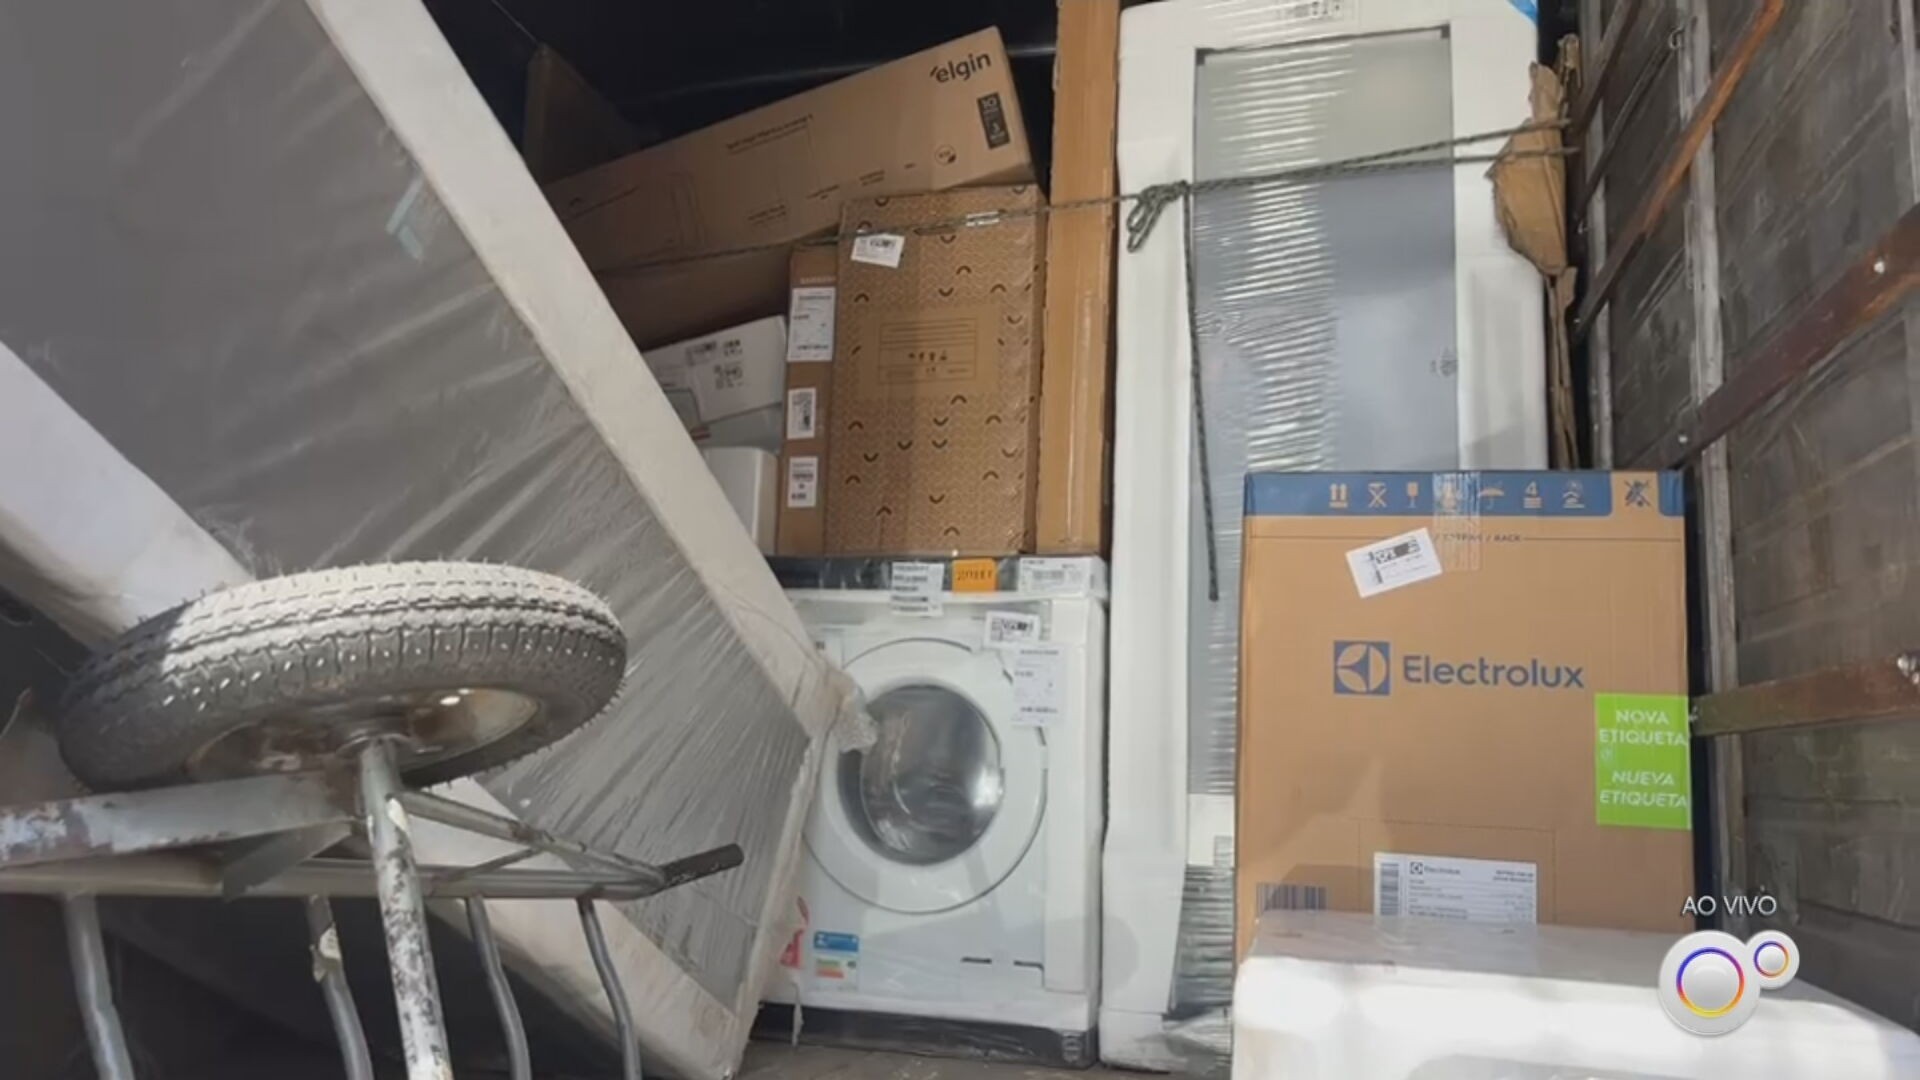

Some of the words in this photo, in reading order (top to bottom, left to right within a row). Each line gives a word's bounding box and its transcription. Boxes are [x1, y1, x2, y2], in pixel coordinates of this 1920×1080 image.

[1403, 654, 1585, 688] Electrolux
[1615, 709, 1671, 725] NOVA
[1599, 728, 1688, 746] ETIQUETA
[1611, 770, 1675, 786] NUEVA
[1599, 789, 1688, 808] ETIQUETA
